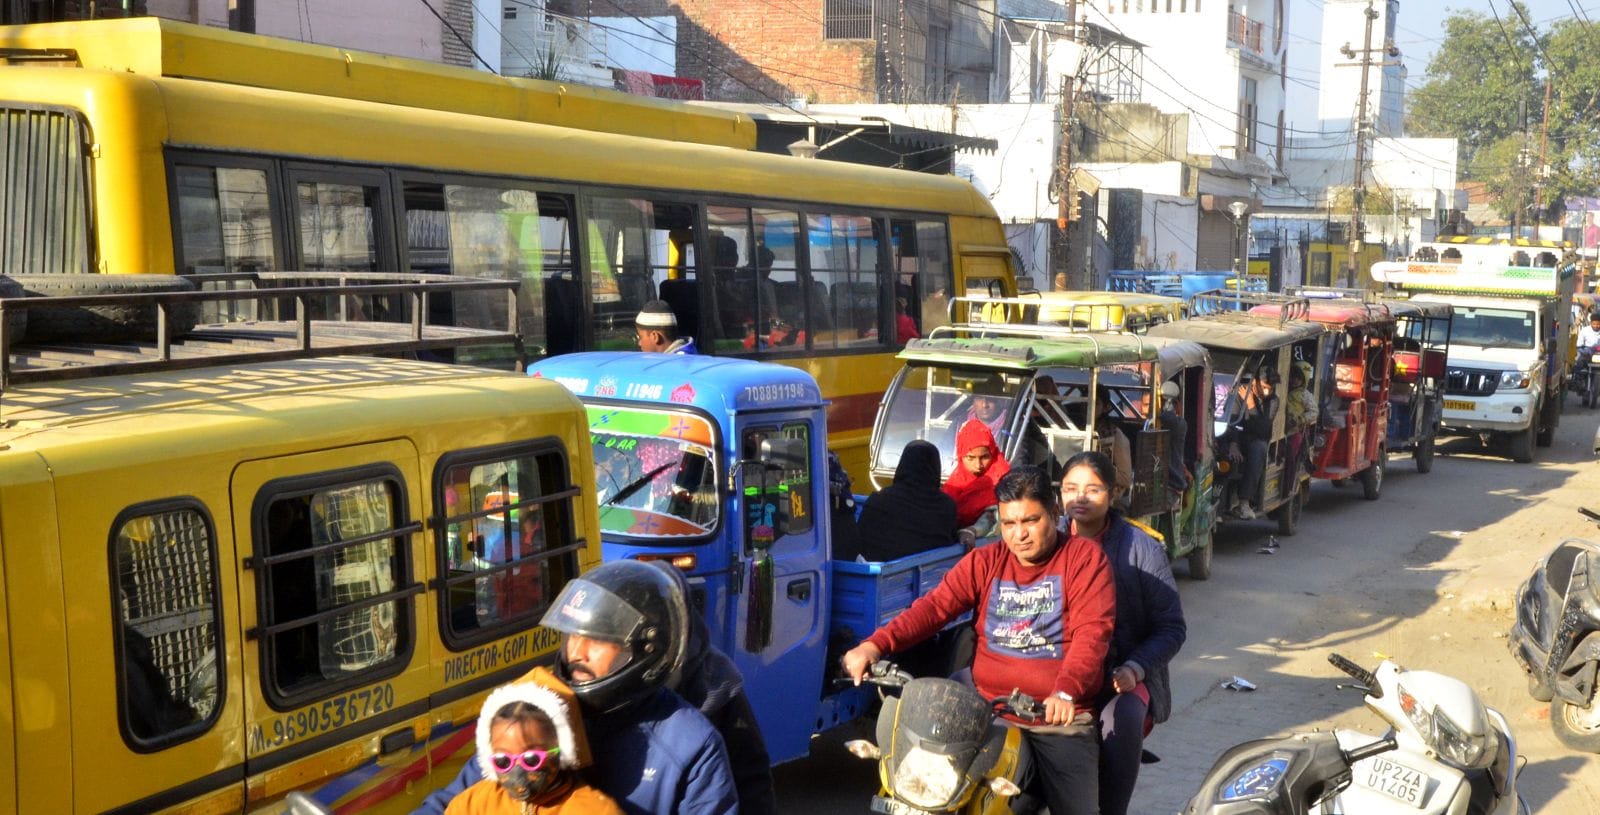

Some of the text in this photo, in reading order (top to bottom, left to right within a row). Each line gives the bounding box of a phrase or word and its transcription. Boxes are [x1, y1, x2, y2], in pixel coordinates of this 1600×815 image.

[744, 383, 804, 401] 7088911946
[532, 626, 561, 652] KRIS
[1372, 758, 1421, 788] UP24A
[1367, 774, 1418, 802] U1405
